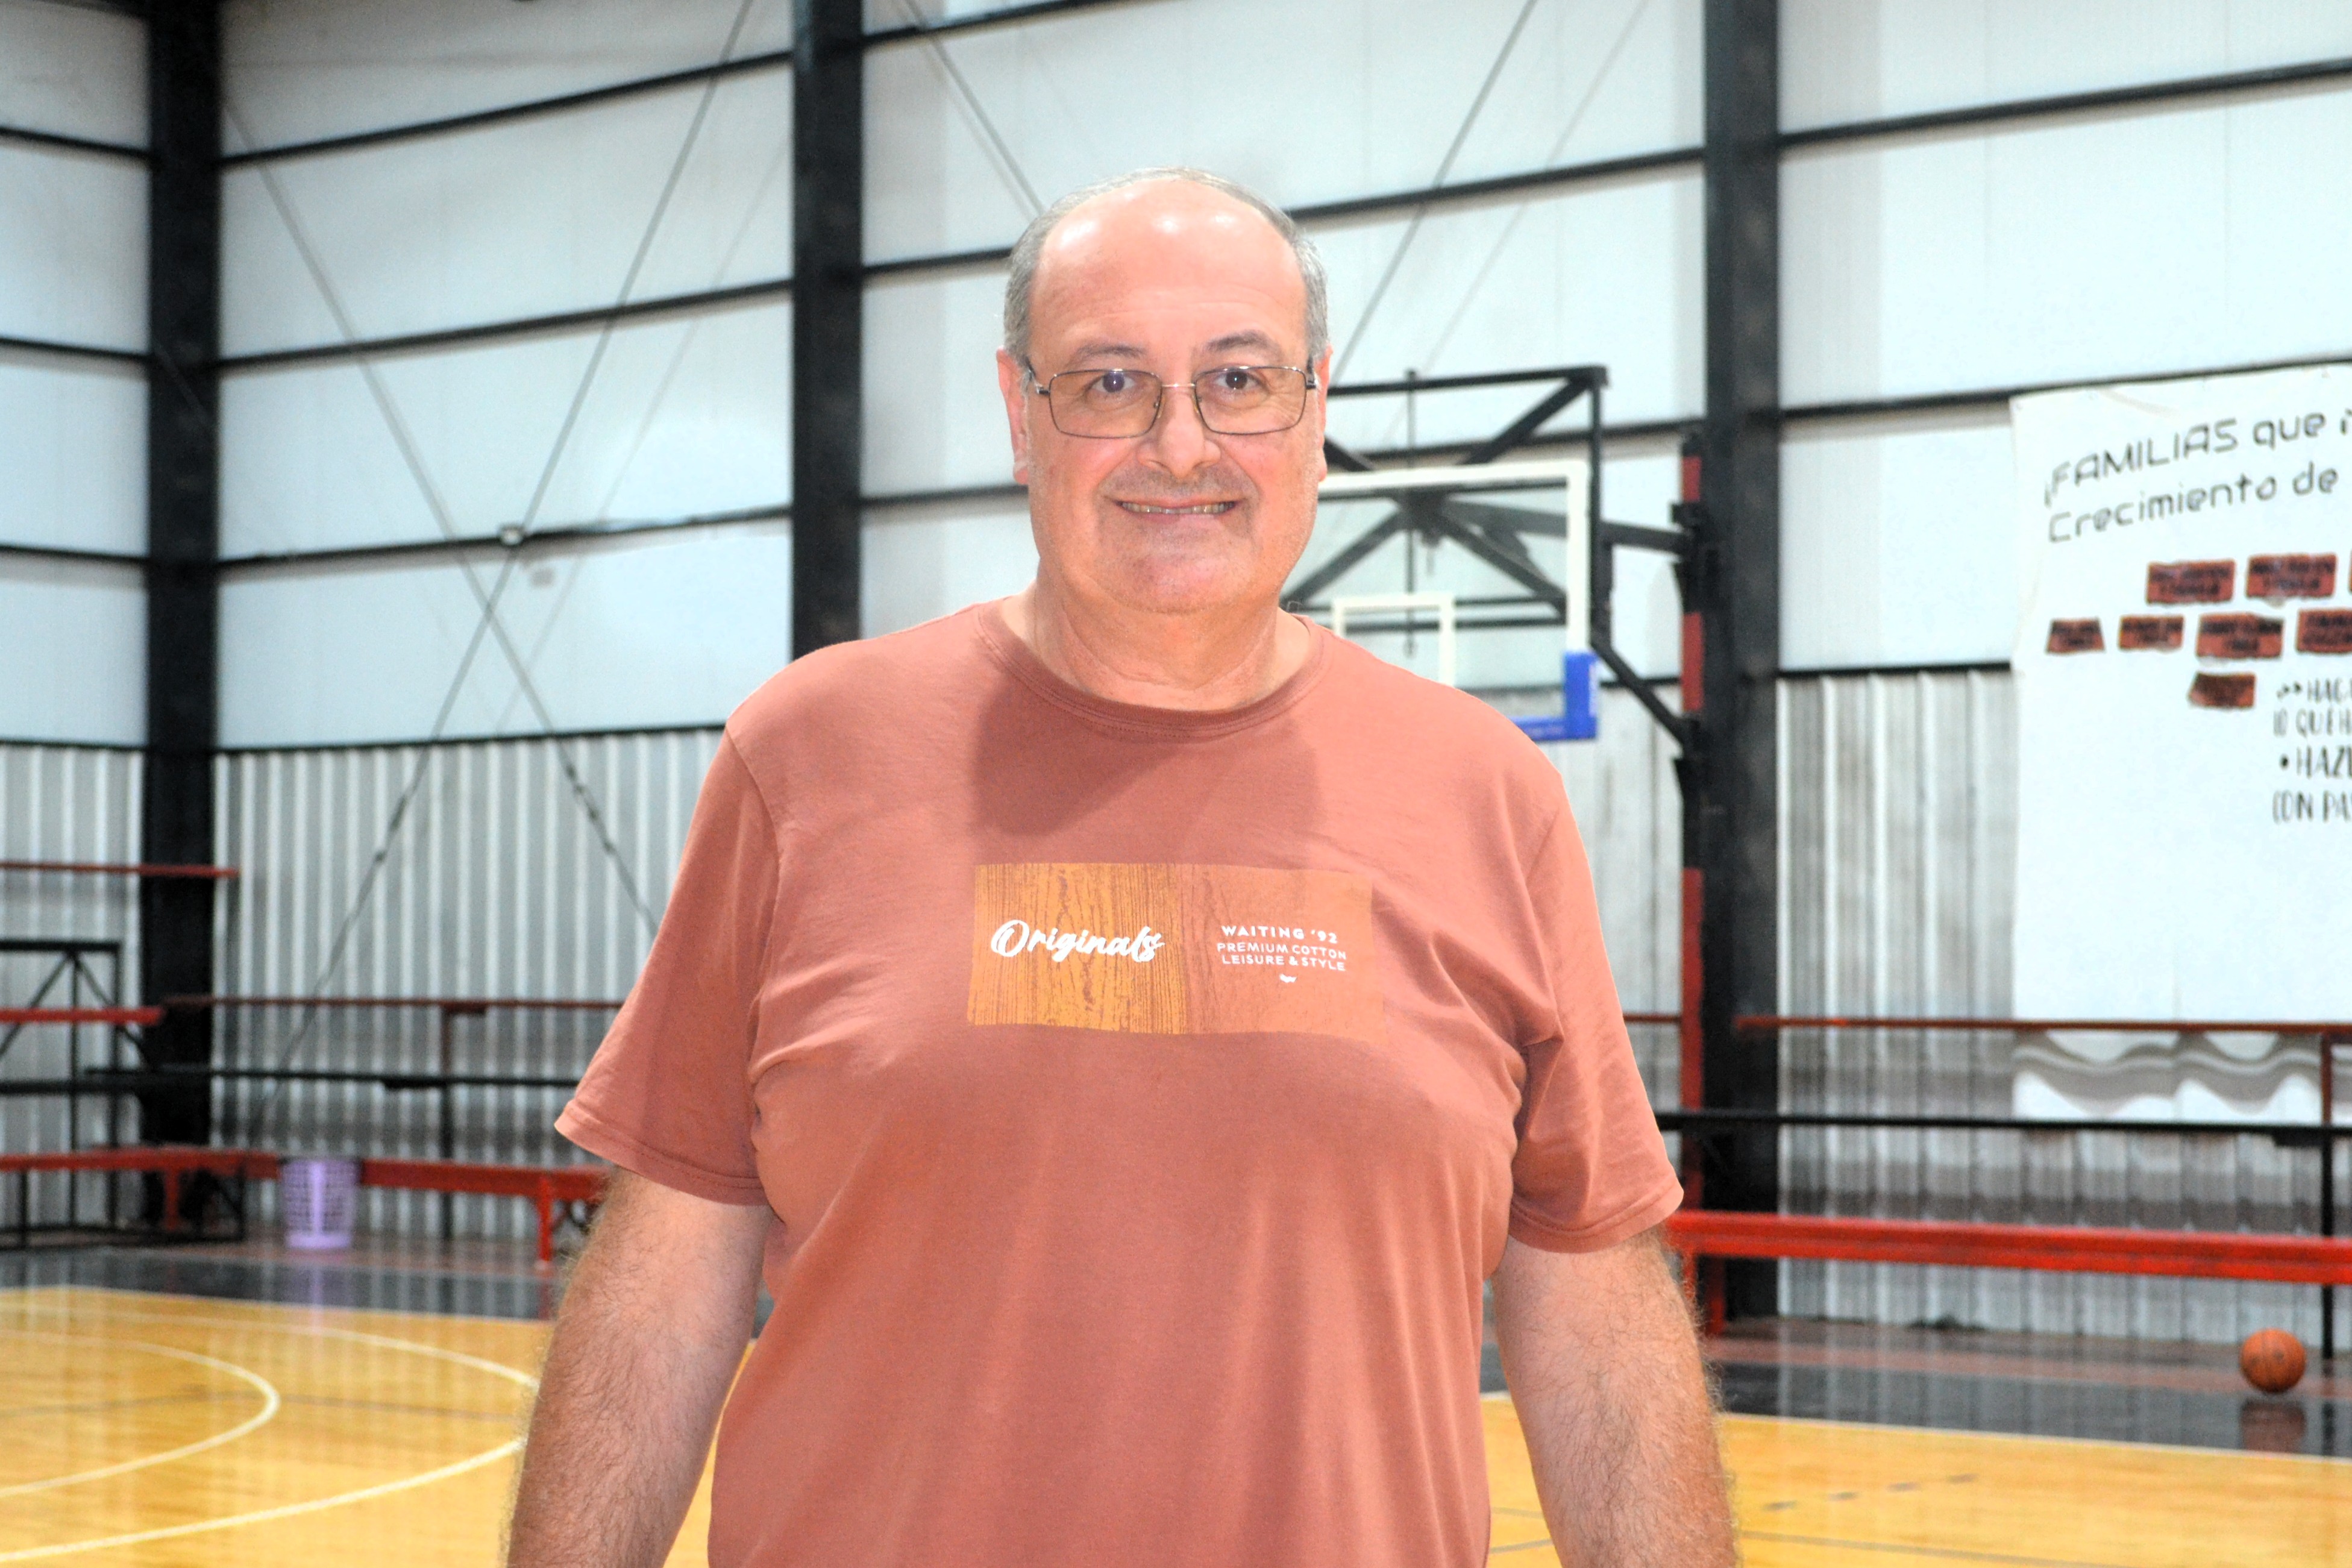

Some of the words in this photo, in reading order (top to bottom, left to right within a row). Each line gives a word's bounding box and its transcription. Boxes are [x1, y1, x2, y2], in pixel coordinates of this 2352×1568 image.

[2251, 412, 2327, 451] que
[2048, 472, 2277, 544] Crecimiento
[2292, 460, 2339, 497] de
[2272, 789, 2314, 824] CON
[2322, 789, 2352, 823] PA
[990, 920, 1165, 962] Originals
[1221, 925, 1305, 940] WAITING
[1217, 941, 1289, 954] PREMIUM
[1291, 944, 1347, 960] COTTON
[1221, 954, 1285, 966] LEISURE
[1288, 955, 1299, 967] &
[1301, 957, 1346, 972] STYLE
